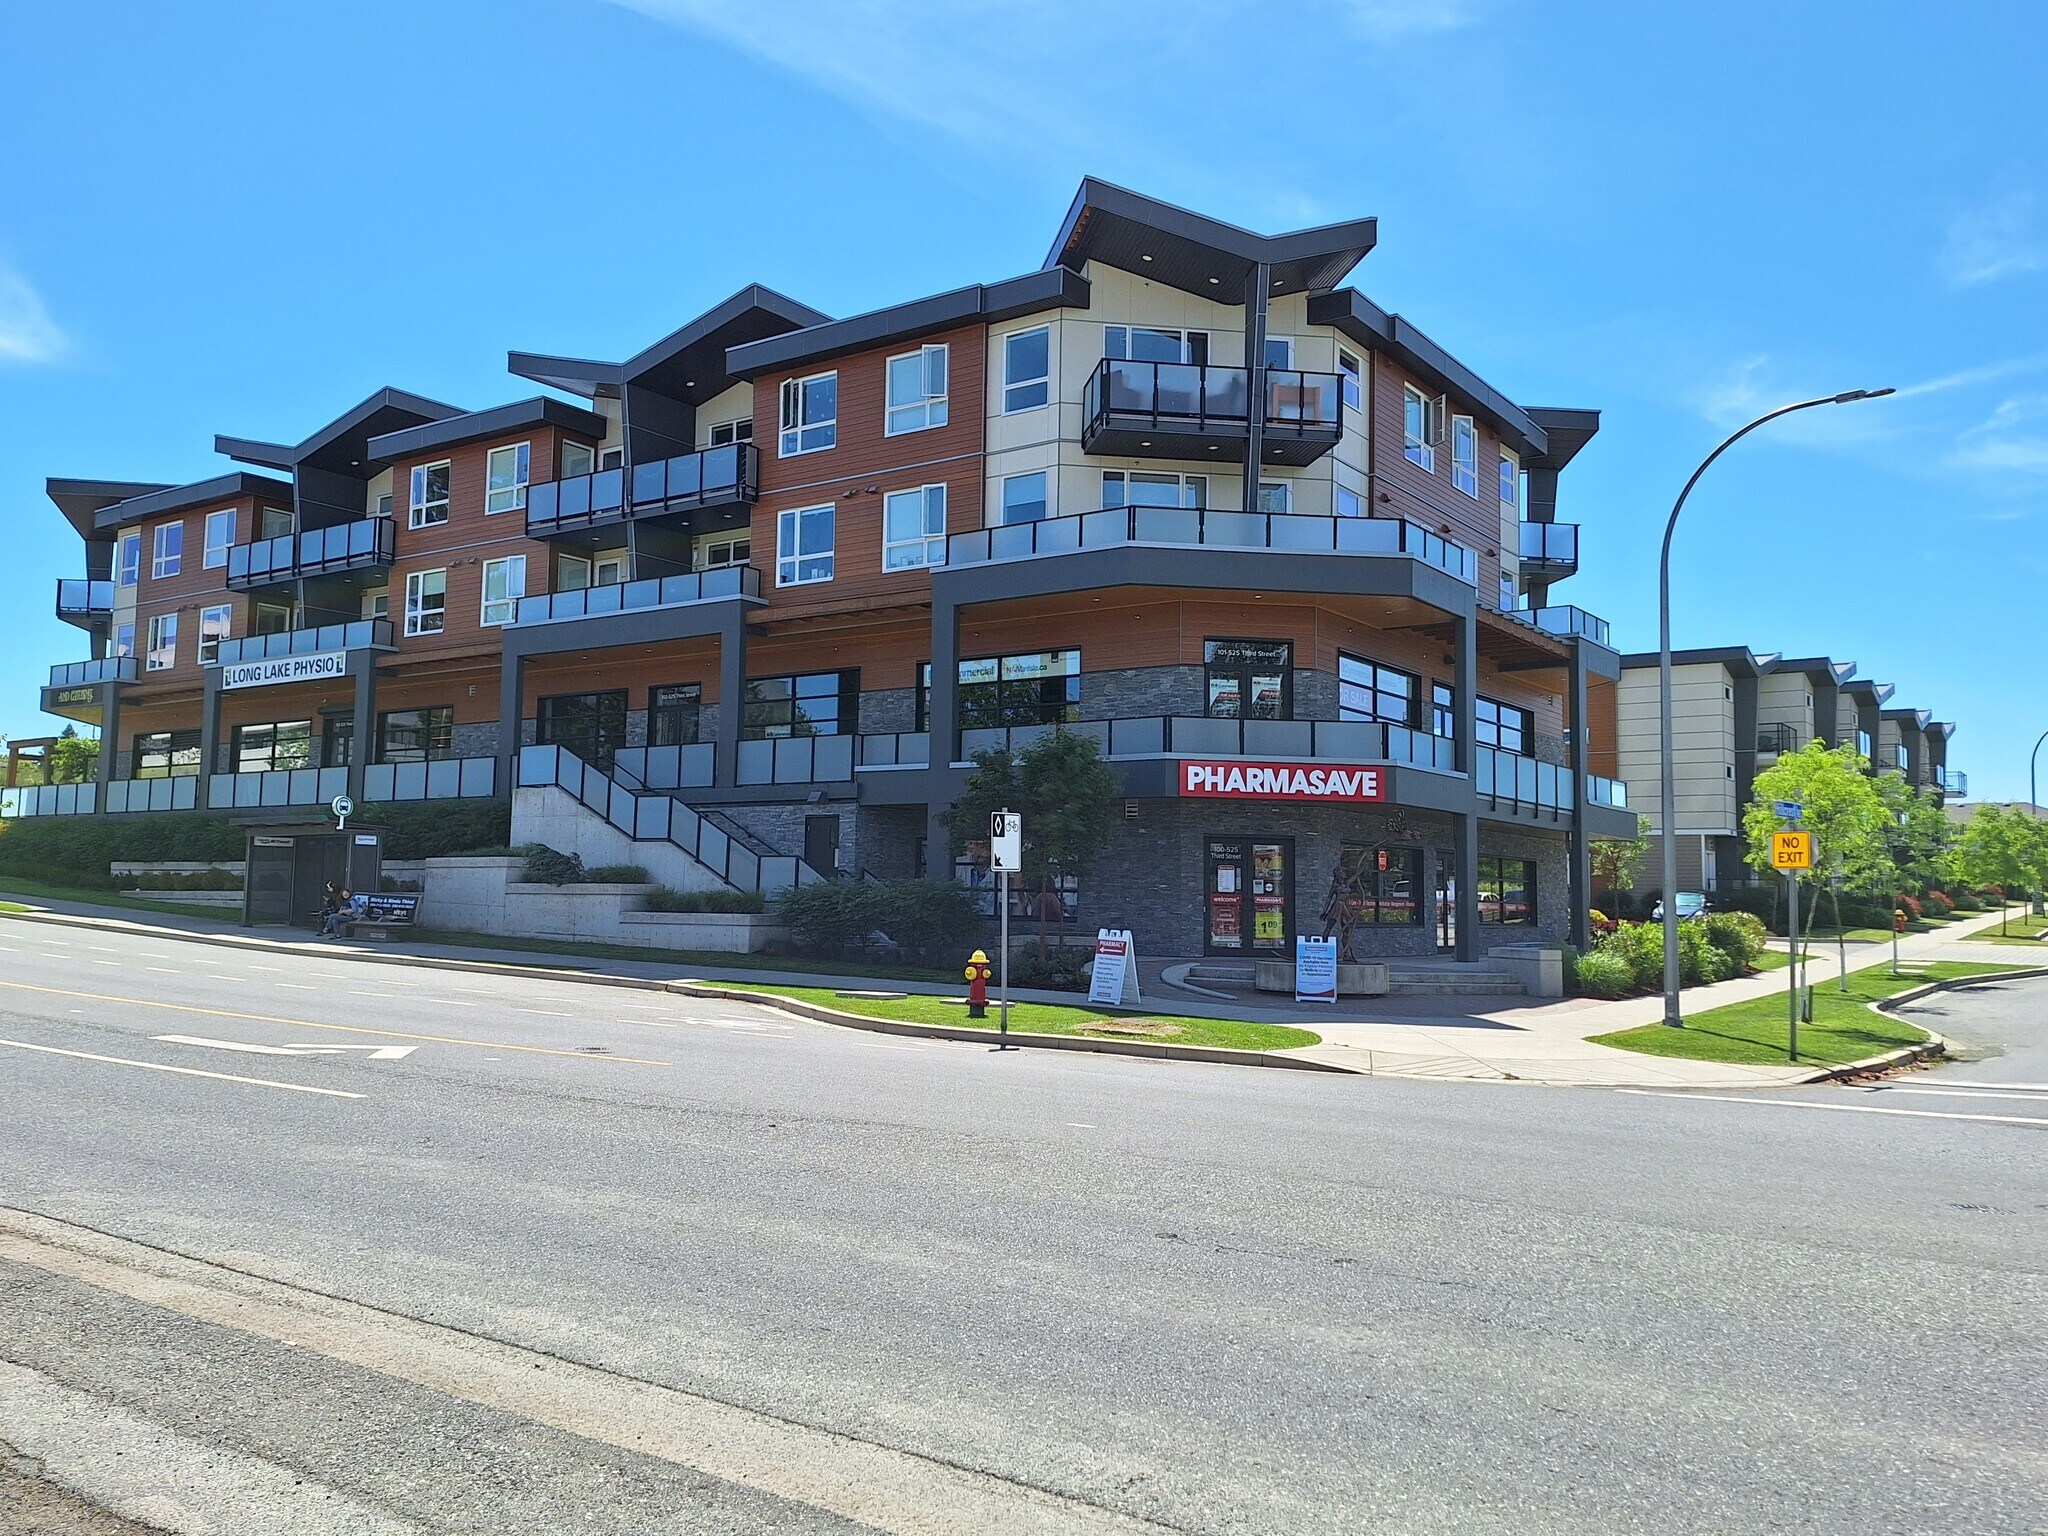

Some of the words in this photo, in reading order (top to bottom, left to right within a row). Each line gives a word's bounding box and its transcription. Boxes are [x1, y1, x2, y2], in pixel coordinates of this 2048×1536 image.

[233, 666, 261, 683] LONG
[264, 662, 290, 679] LAKE
[293, 657, 334, 676] PHYSIO
[1350, 691, 1368, 708] SALE
[1187, 765, 1378, 797] PHARMASAVE
[1782, 837, 1800, 849] NO
[1778, 851, 1804, 863] EXIT
[1100, 940, 1125, 948] PHARMACY
